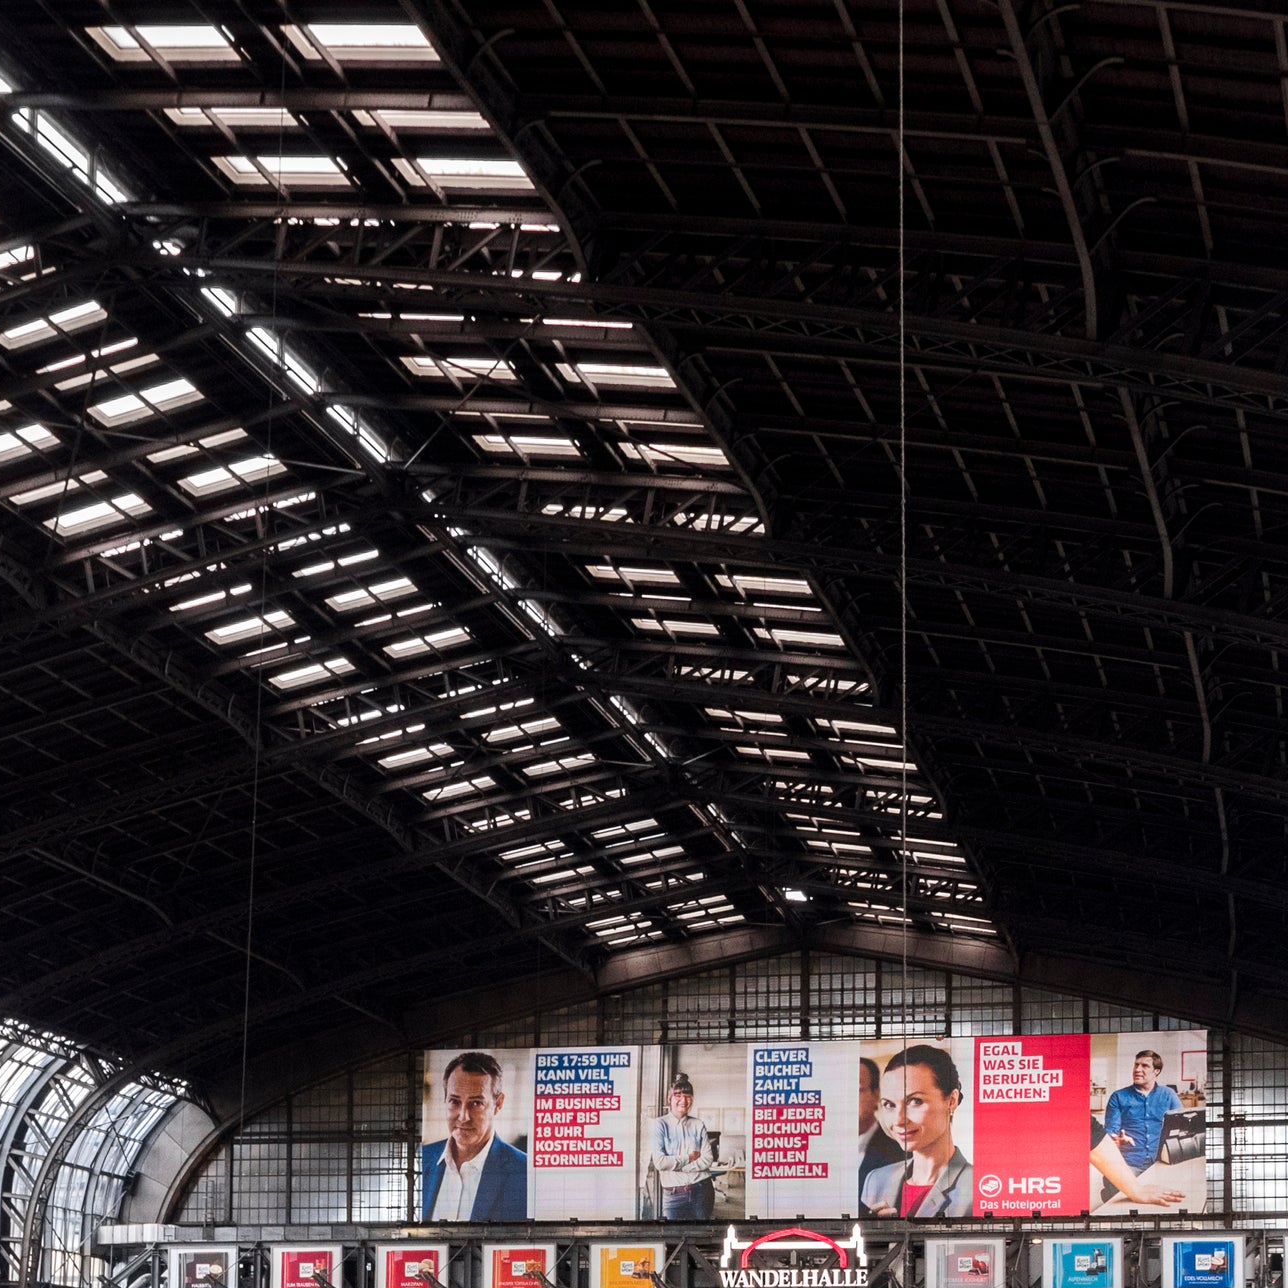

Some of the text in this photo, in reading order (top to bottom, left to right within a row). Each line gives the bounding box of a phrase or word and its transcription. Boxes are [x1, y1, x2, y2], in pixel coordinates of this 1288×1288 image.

[755, 1050, 807, 1062] CLEVER
[983, 1045, 1018, 1056] EGAL
[537, 1054, 629, 1067] BIS 17:59 UHR
[983, 1058, 1040, 1070] WAS SIE
[537, 1068, 608, 1080] KANN VIEL
[755, 1064, 810, 1077] BUCHEN
[754, 1078, 798, 1091] ZAHLT
[983, 1073, 1060, 1085] BERUFLICH
[536, 1082, 612, 1095] PASSIEREN:
[982, 1088, 1047, 1100] MACHEN:
[536, 1097, 619, 1110] IM BUSINESS
[754, 1092, 819, 1105] SICH AUS:
[536, 1112, 598, 1124] TARIF BIS
[754, 1108, 823, 1120] BEI JEDER
[536, 1126, 583, 1137] 18 UHR
[754, 1122, 820, 1134] BUCHUNG
[535, 1140, 612, 1151] KOSTENLOS
[754, 1137, 807, 1149] BONUS-
[535, 1153, 621, 1166] STORNIEREN.
[754, 1150, 805, 1163] MEILEN
[754, 1165, 826, 1177] SAMMELN.
[1008, 1176, 1061, 1194] HRS
[979, 1199, 1061, 1211] Das Hotelportal
[718, 1268, 869, 1288] WANDELHALLE
